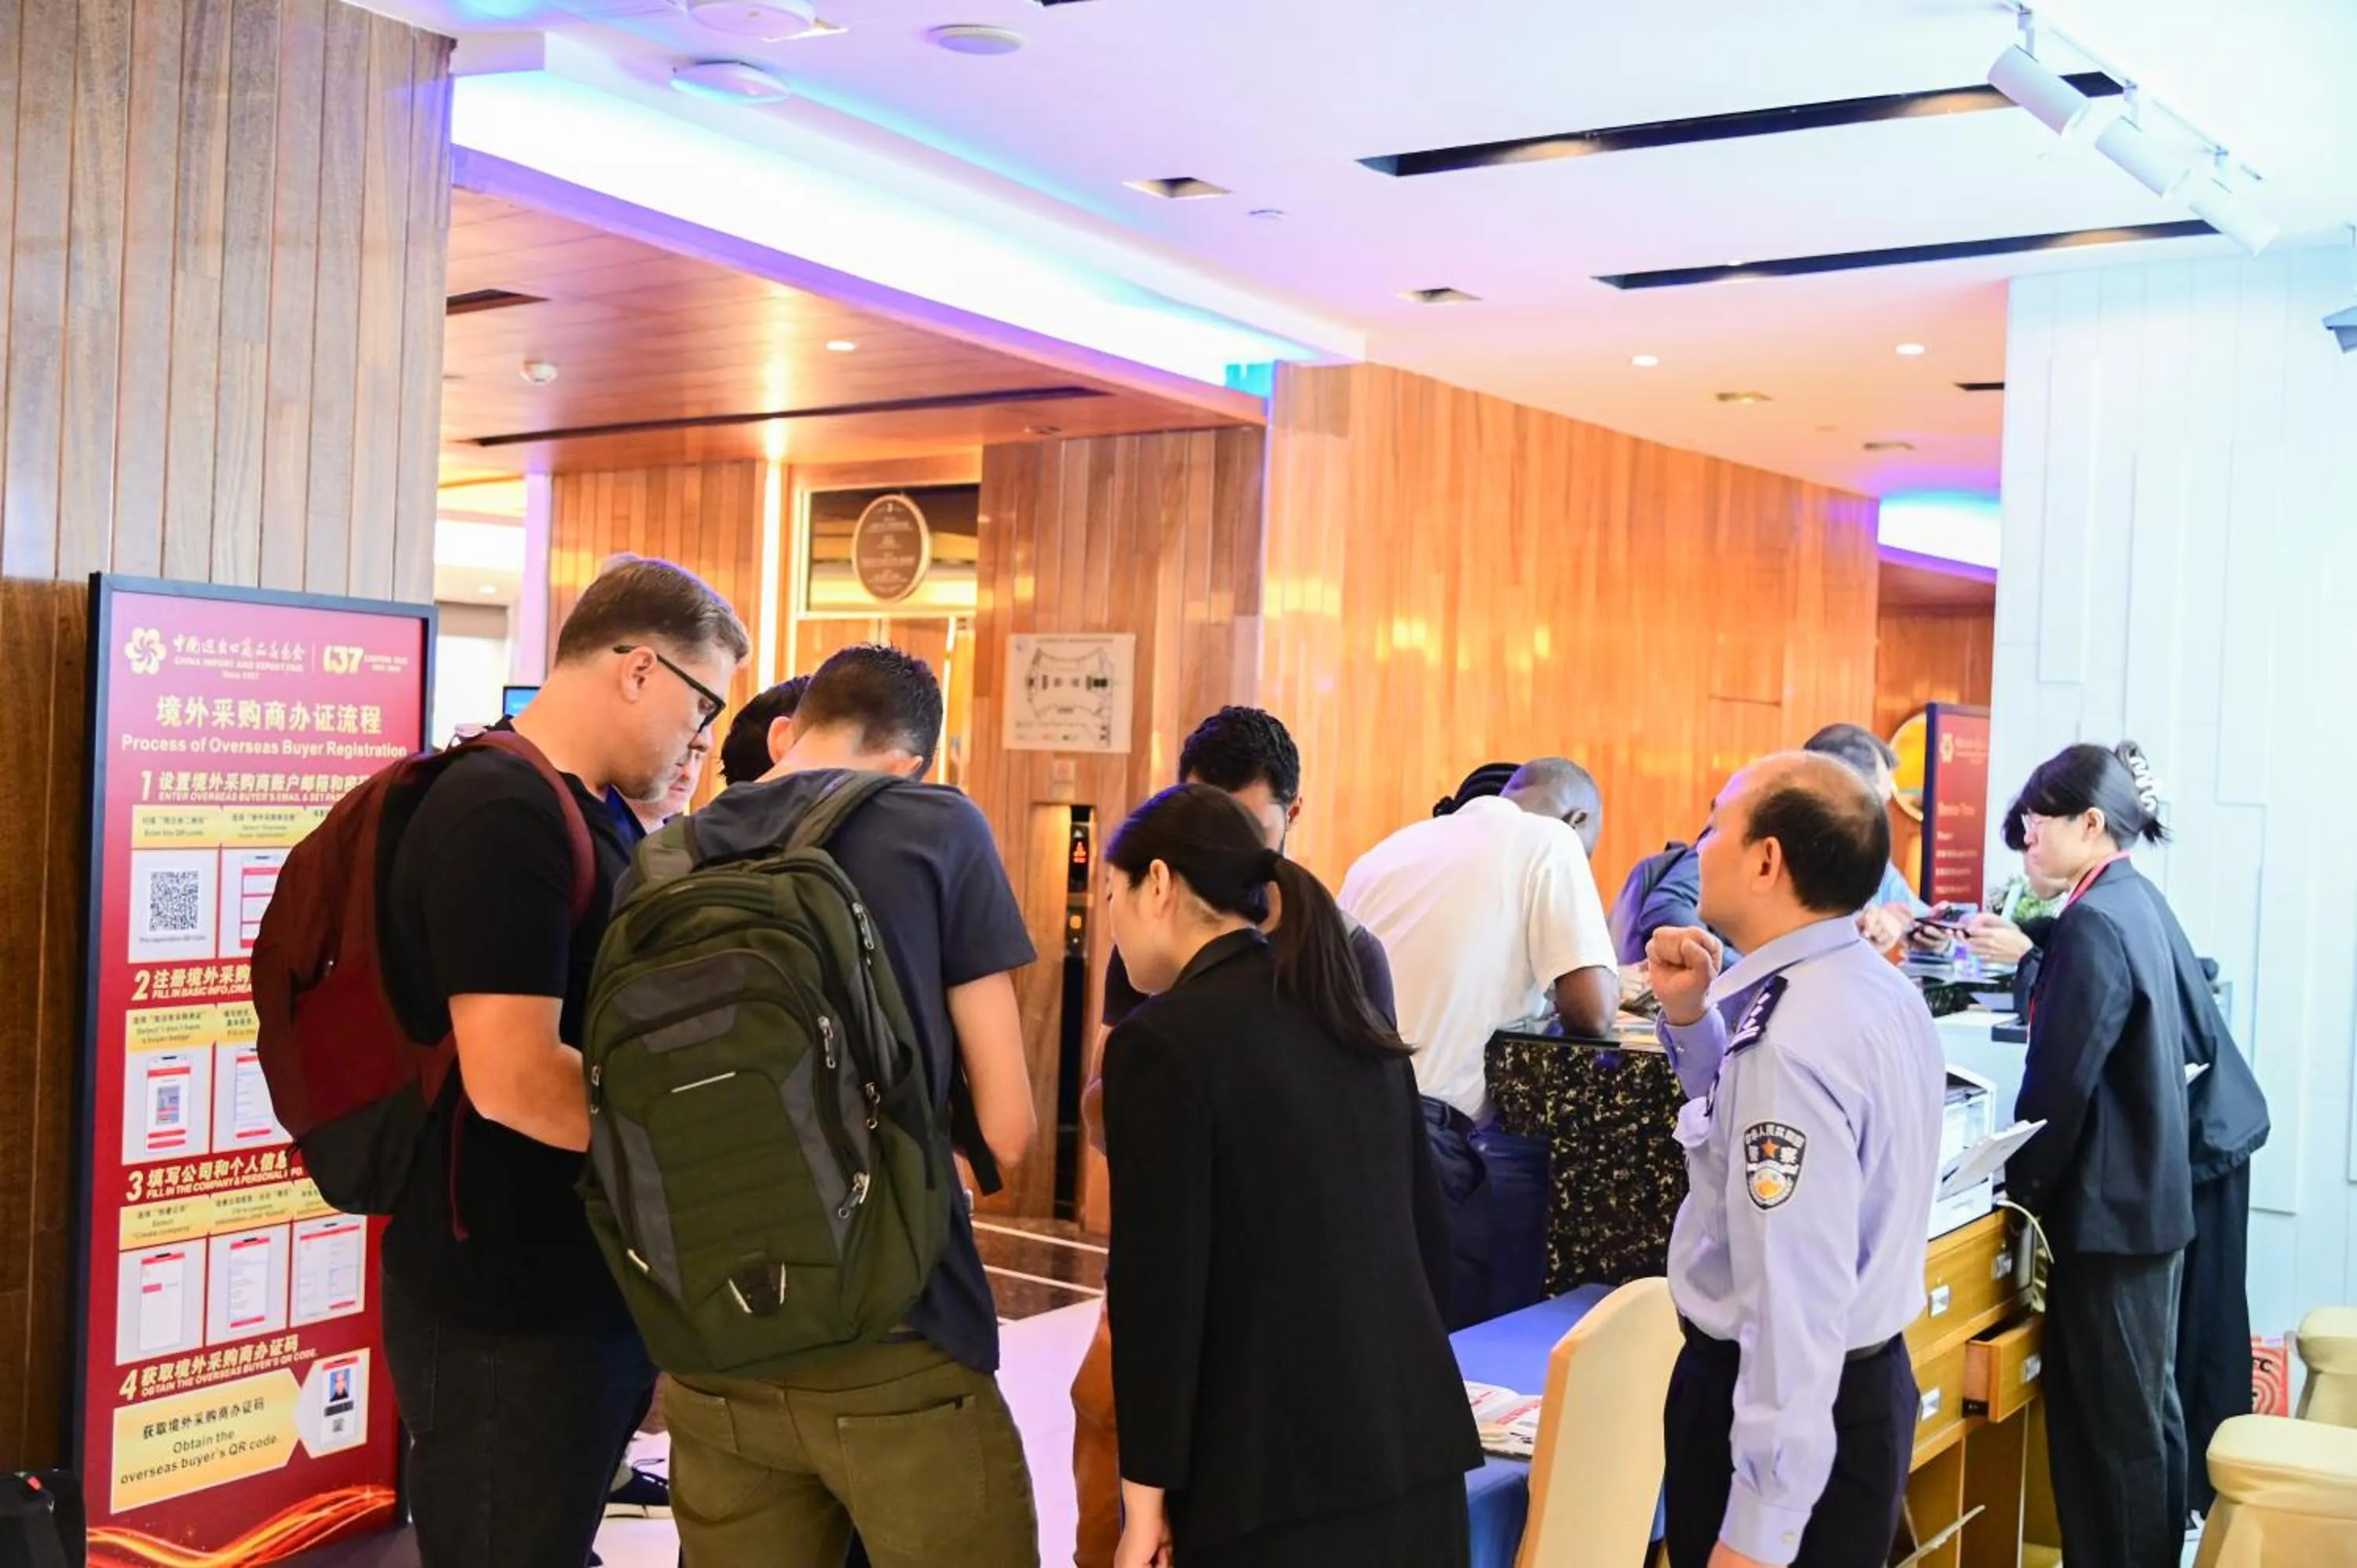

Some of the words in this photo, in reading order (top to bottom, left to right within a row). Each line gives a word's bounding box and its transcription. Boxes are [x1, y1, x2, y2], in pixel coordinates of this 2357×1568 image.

[174, 655, 201, 666] CHINA
[156, 694, 383, 735] 境外采购商办证流程
[122, 733, 188, 752] Process
[191, 736, 207, 753] of
[209, 736, 279, 755] Overseas
[282, 738, 324, 760] Buyer
[327, 741, 408, 760] Registration
[141, 769, 152, 802] 1
[159, 791, 189, 801] ENTER
[190, 791, 237, 802] OVERSEAS
[131, 969, 150, 1002] 2
[152, 988, 170, 1000] FILL
[171, 987, 181, 998] IN
[181, 986, 207, 997] BASIC
[126, 1169, 144, 1202] 3
[146, 1188, 163, 1200] FILL
[165, 1186, 175, 1196] IN
[176, 1183, 192, 1194] THE
[193, 1178, 233, 1192] COMPANY
[241, 1171, 283, 1185] PERSONAL
[147, 1150, 288, 1189] 填写公司和个人信息
[141, 1333, 299, 1389] 获取境外采购商办证码
[141, 1381, 176, 1398] OBTAIN
[178, 1377, 194, 1389] THE
[196, 1365, 242, 1385] OVERSEAS
[244, 1357, 279, 1373] BUYER'S
[280, 1353, 292, 1365] QR
[119, 1368, 138, 1401] 4
[143, 1396, 266, 1440] 获取境外采购商办证码
[173, 1435, 213, 1454] Obtain
[216, 1430, 235, 1443] the
[120, 1462, 178, 1485] overseas
[181, 1447, 227, 1469] buyer's
[229, 1441, 247, 1456] QR
[249, 1434, 278, 1451] code
